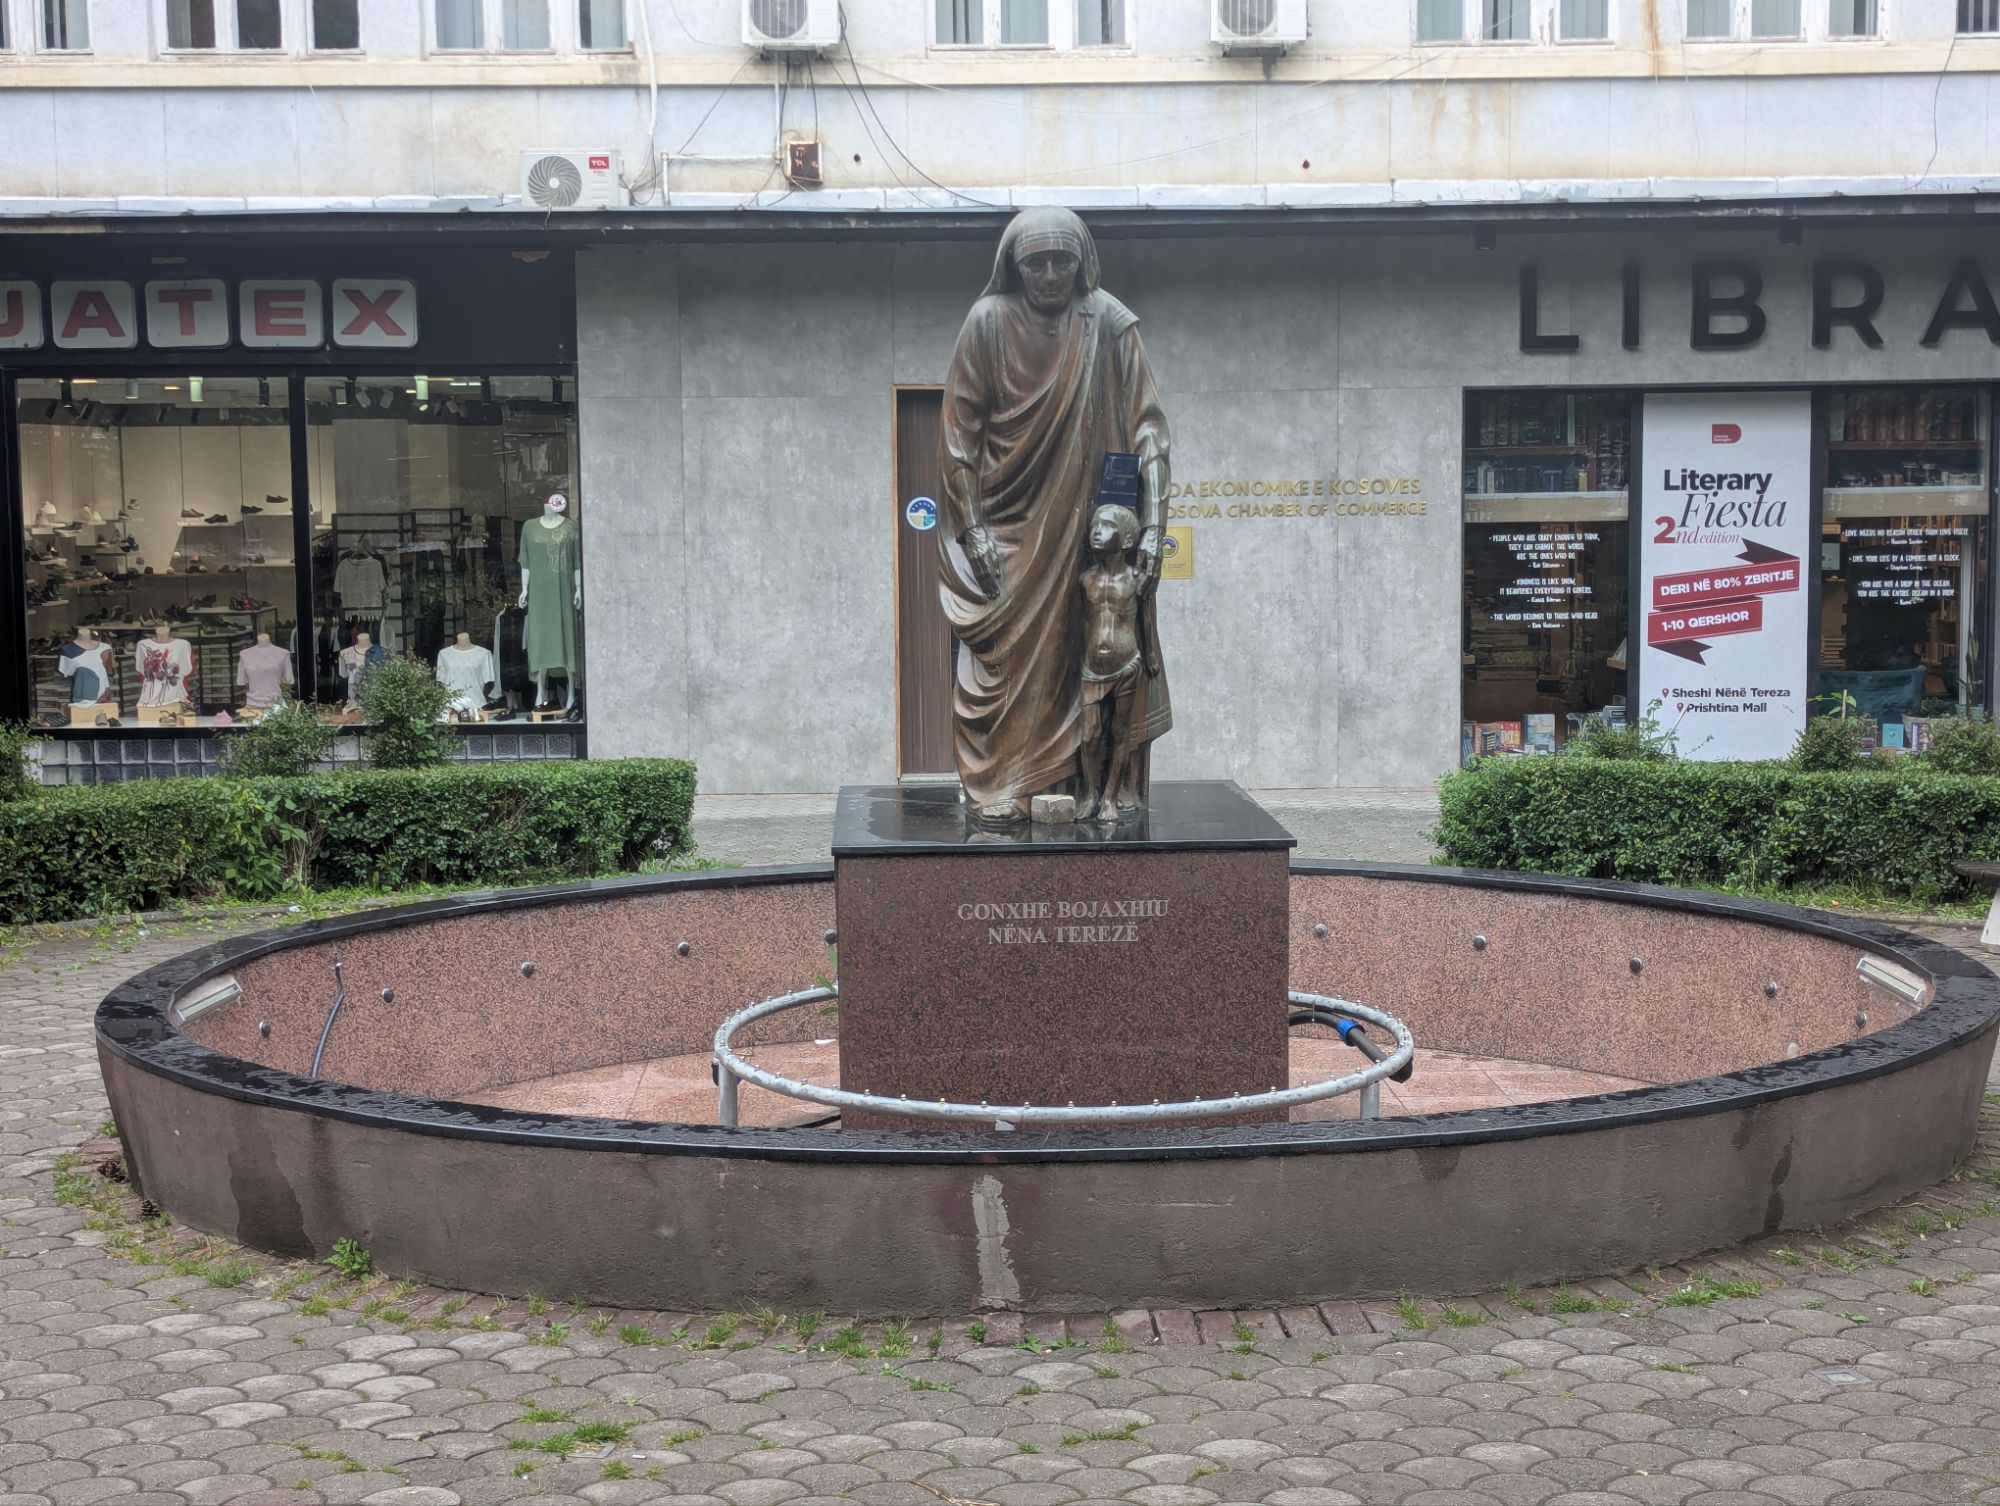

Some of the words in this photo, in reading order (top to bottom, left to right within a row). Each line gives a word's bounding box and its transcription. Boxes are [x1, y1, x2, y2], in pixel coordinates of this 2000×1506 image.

[1519, 260, 2000, 350] LIBRA
[1168, 482, 1196, 498] DA
[1200, 480, 1309, 497] EKONOMIKE
[1314, 480, 1324, 496] E
[1664, 468, 1772, 494] Literary
[1168, 503, 1222, 519] OSOVA
[1228, 502, 1303, 518] CHAMBER
[1308, 503, 1328, 517] OF
[1336, 501, 1428, 516] COMMERCE
[1677, 490, 1788, 528] Fiesta
[1654, 516, 1700, 544] 2nd
[1700, 528, 1740, 544] edition
[1661, 584, 1690, 596] DERI
[1693, 578, 1710, 592] NË
[1714, 577, 1741, 588] 80%
[1744, 570, 1794, 586] ZBRITJE
[1662, 620, 1684, 632] 1-10
[1688, 611, 1750, 628] QERSHOR
[1672, 688, 1712, 698] Sheshi
[1716, 688, 1746, 698] Nënë
[1750, 688, 1790, 698] Tereza
[1687, 702, 1738, 712] Prishtina
[1743, 702, 1767, 712] Mall
[957, 902, 1052, 920] GONXHE
[1057, 900, 1169, 918] BOJAXHIU
[988, 924, 1047, 944] NËNA
[1054, 922, 1139, 944] TEREZË
